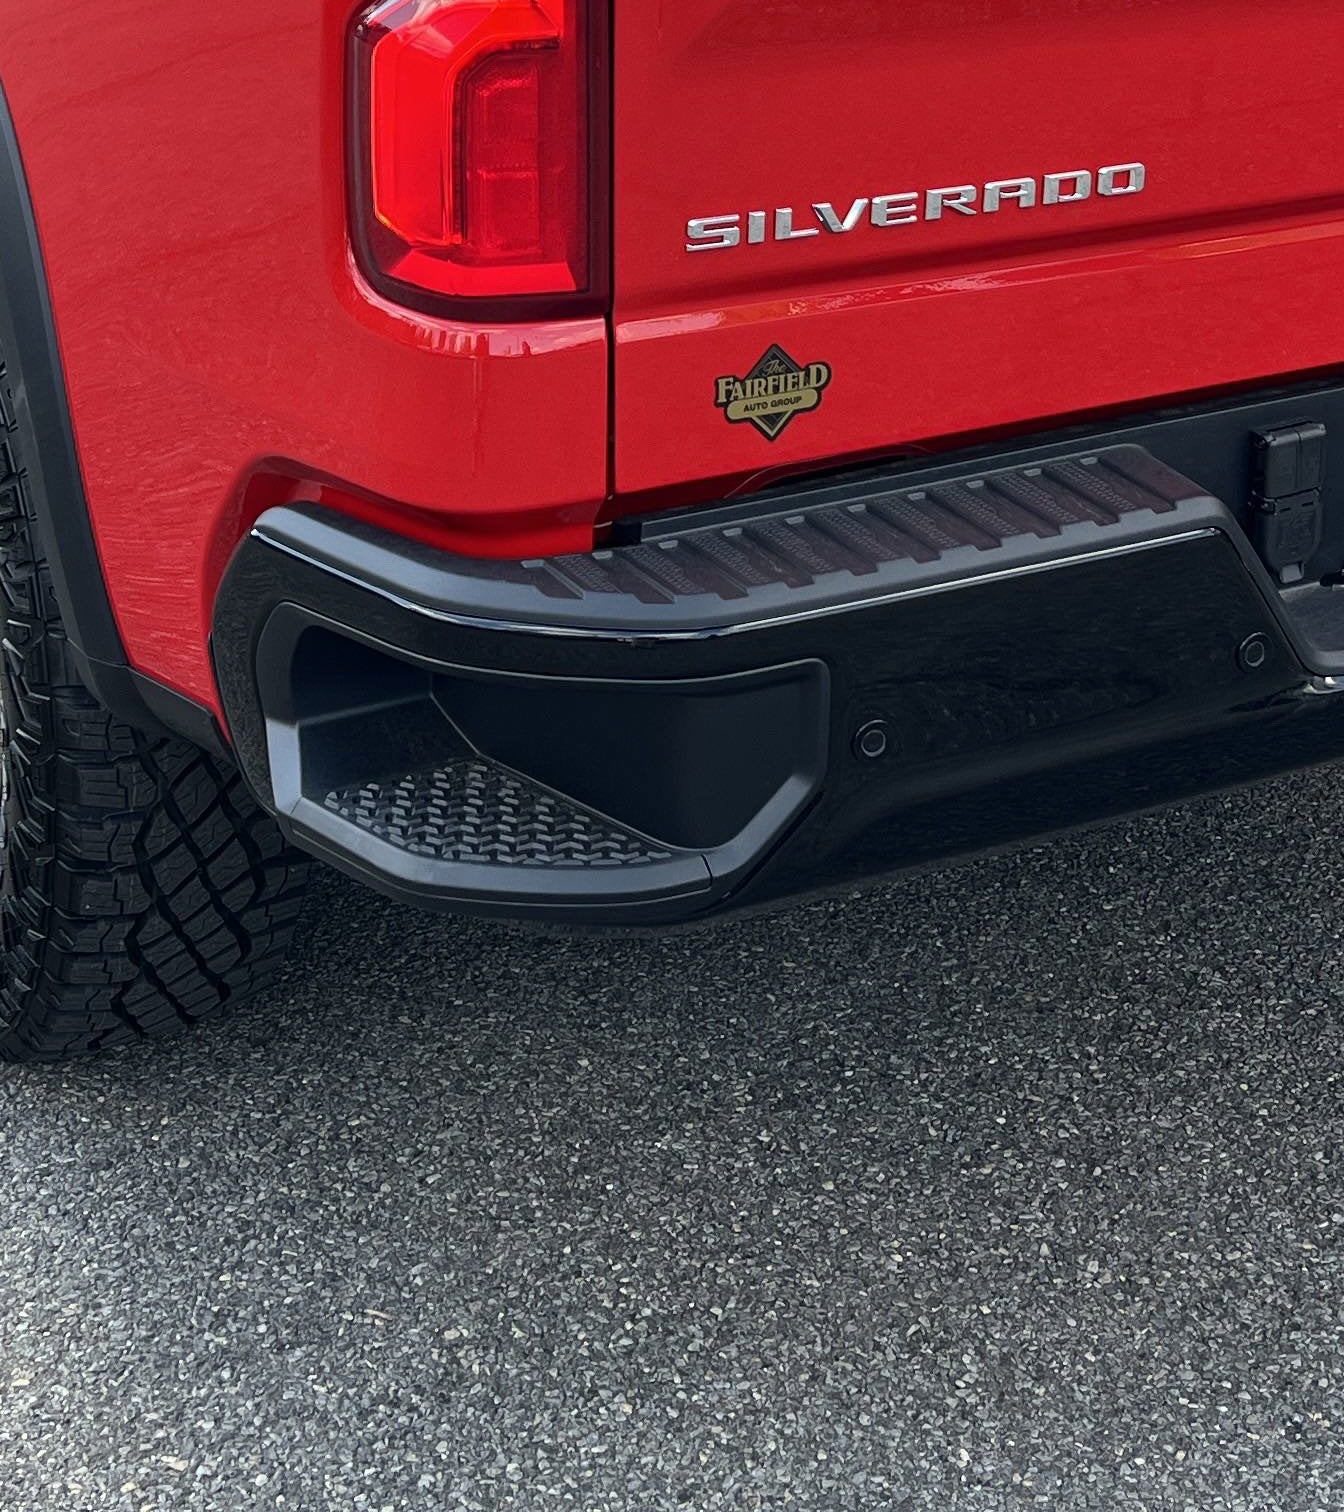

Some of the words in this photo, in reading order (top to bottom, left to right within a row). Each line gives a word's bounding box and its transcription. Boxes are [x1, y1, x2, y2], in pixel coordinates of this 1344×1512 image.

[685, 161, 1146, 253] SILVERADO
[717, 363, 829, 404] FAIRFIELD
[744, 401, 769, 413] AUTO
[771, 395, 803, 408] GROUP
